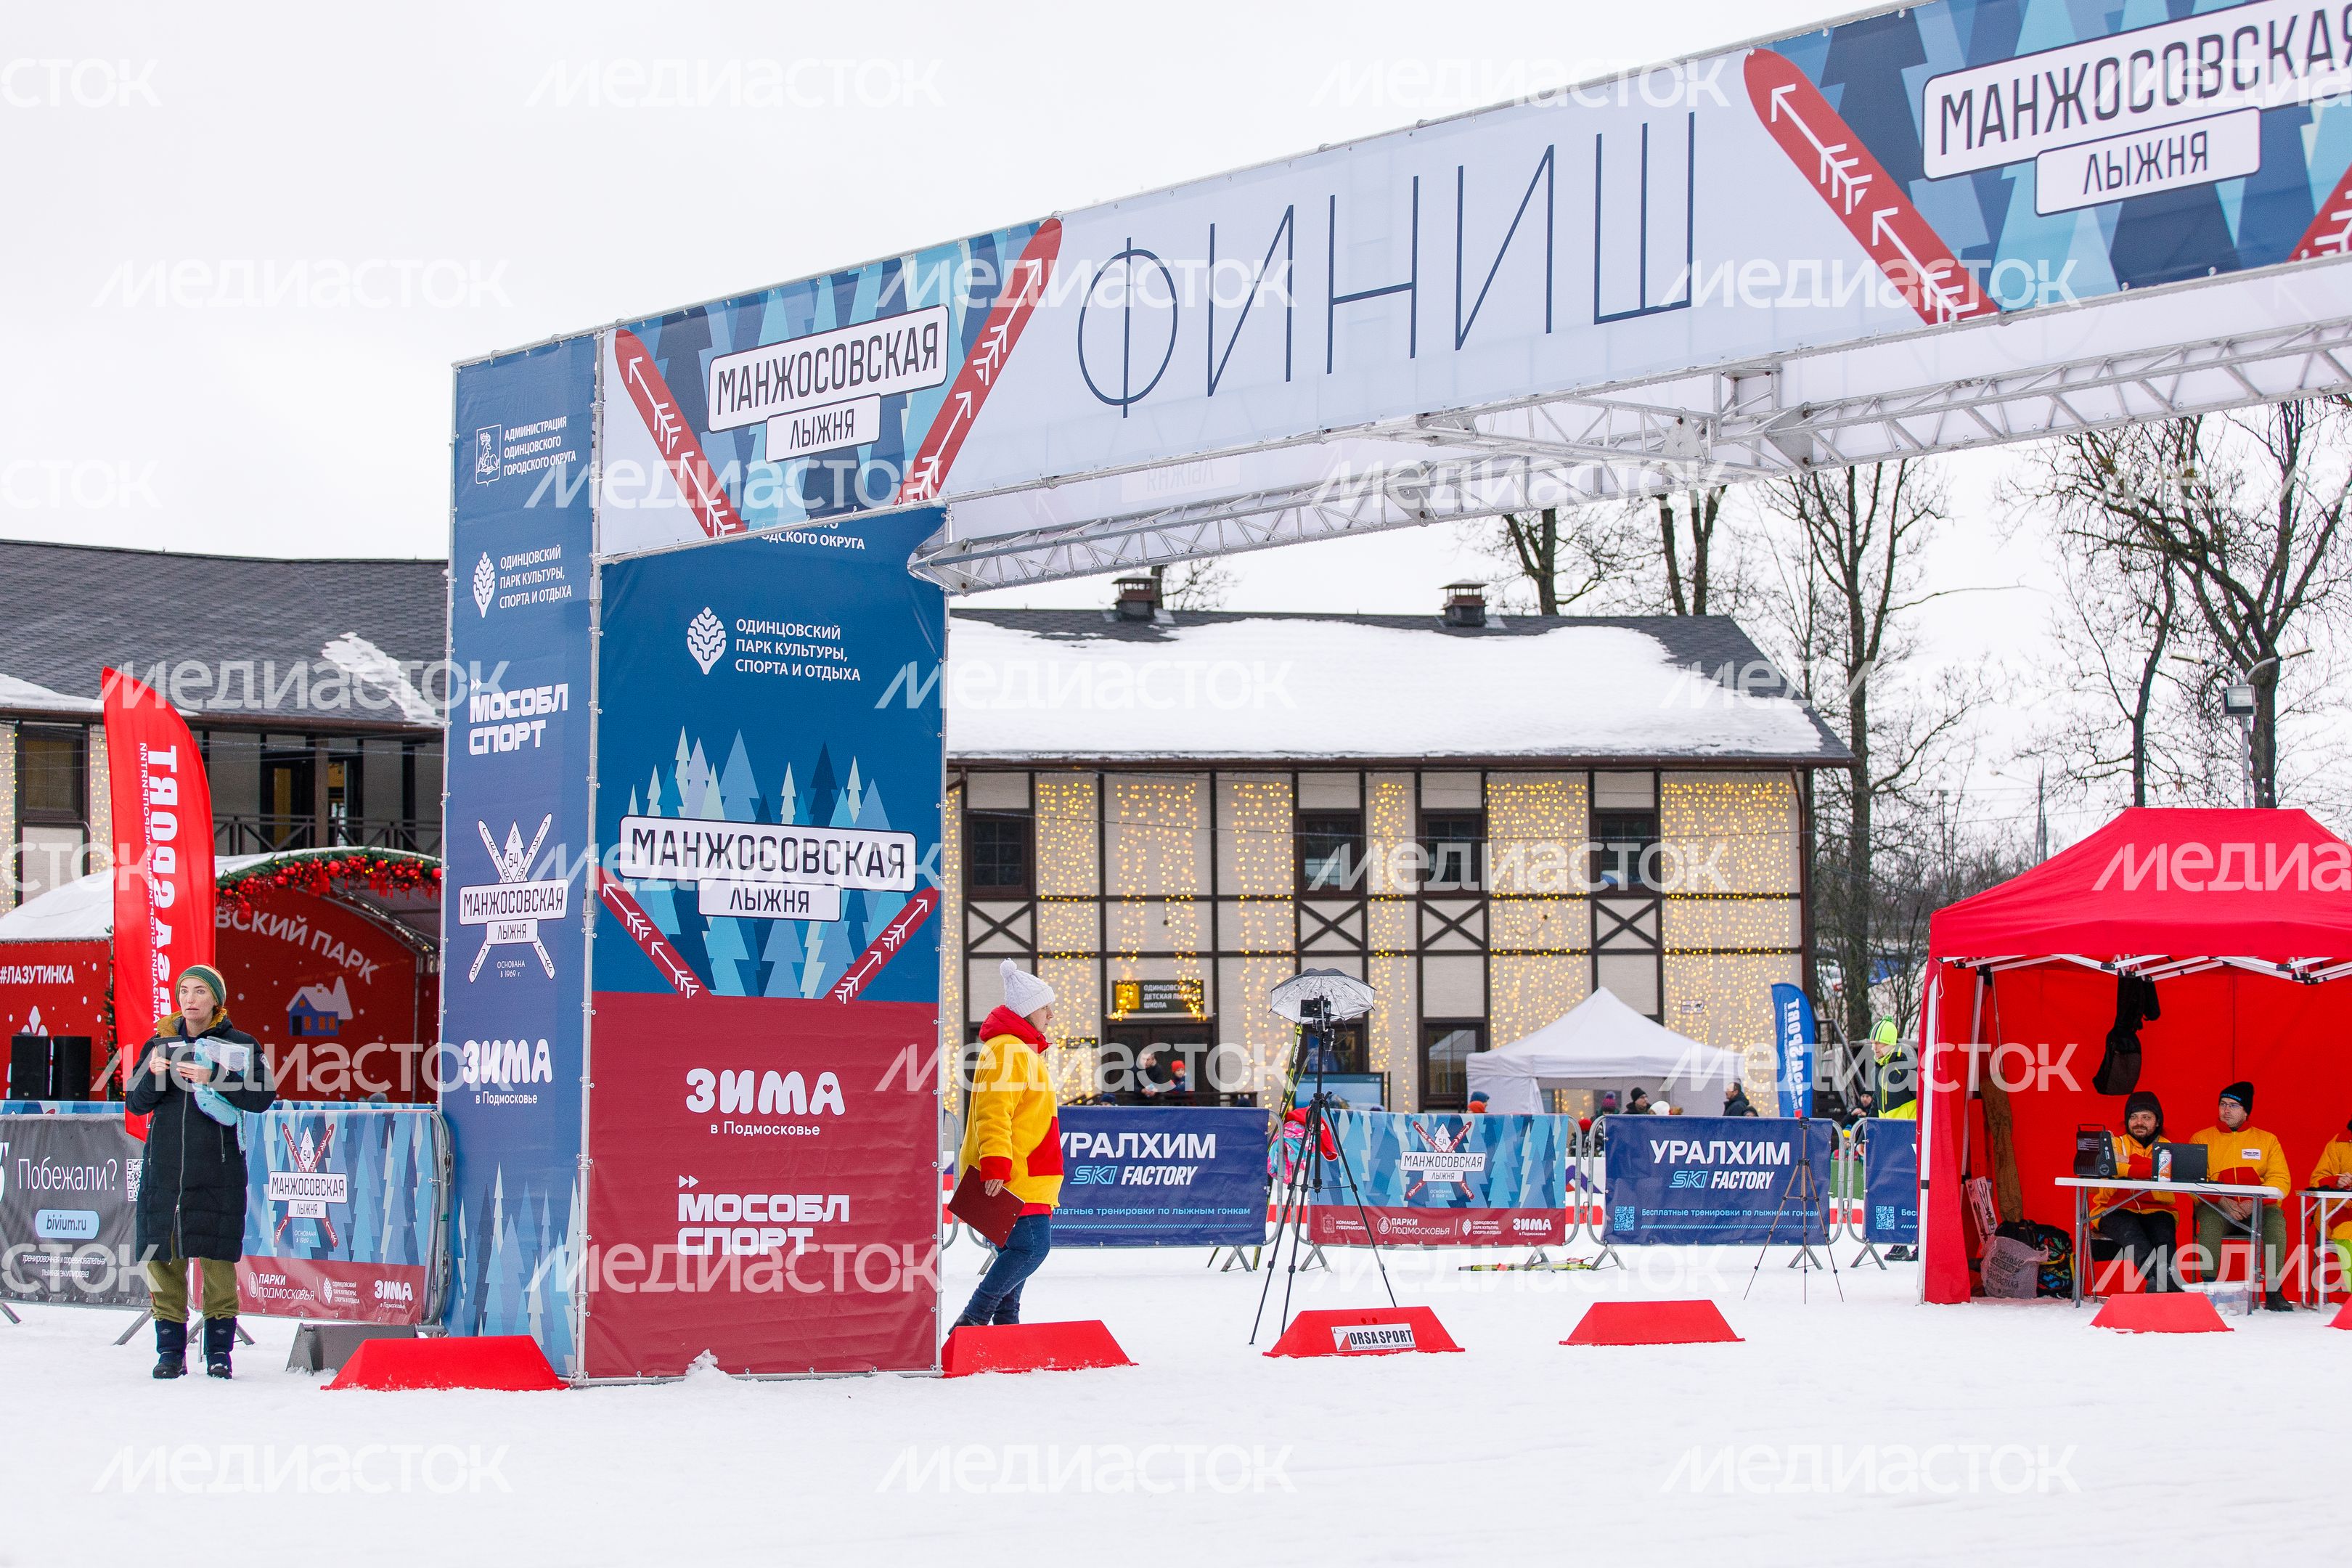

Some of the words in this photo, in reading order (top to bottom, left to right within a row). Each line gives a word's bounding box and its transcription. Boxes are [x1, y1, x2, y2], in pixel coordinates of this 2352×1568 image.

[2083, 130, 2209, 195] ЛЫЖНЯ
[1077, 111, 1694, 420] ФИНИШ
[717, 321, 939, 415] МАНЖОСОВСКАЯ
[504, 416, 567, 441] АДМИНИСТРАЦИЯ
[788, 408, 855, 450] ЛЫЖНЯ
[504, 436, 561, 460] ОДИНЦОВСКОГО
[504, 456, 548, 476] ГОРОДСКОГО
[550, 450, 576, 468] ОКРУГА
[820, 535, 865, 550] ОКРУГА
[500, 545, 561, 571] ОДИНЦОВСКИЙ
[500, 574, 520, 589] ПАРК
[522, 567, 565, 587] КУЛЬТУРЫ,
[499, 592, 529, 609] СПОРТА
[531, 590, 538, 603] И
[539, 584, 571, 605] ОТДЫХА
[736, 618, 841, 640] ОДИНЦОВСКИЙ
[735, 639, 772, 653] ПАРК
[775, 642, 848, 662] КУЛЬТУРЫ,
[735, 659, 788, 676] СПОРТА
[792, 665, 801, 676] И
[805, 664, 861, 681] ОТДЫХА
[470, 684, 568, 723] МОСОБЛ
[469, 720, 547, 756] СПОРТ
[509, 852, 519, 867] 54
[632, 828, 905, 880] МАНЖОСОВСКАЯ
[463, 888, 564, 917] МАНЖОСОВСКАЯ
[730, 886, 809, 913] ЛЫЖНЯ
[497, 923, 526, 940] ЛЫЖНЯ
[311, 930, 379, 984] ПАРК
[0, 965, 74, 984] #ЛАЗУТИНКА
[462, 1038, 552, 1084] ЗИМА
[483, 1090, 537, 1106] Подмосковье
[685, 1068, 845, 1116] ЗИМА
[711, 1124, 718, 1135] в
[724, 1121, 820, 1137] Подмосковье
[1439, 1138, 1447, 1146] 54
[1650, 1140, 1790, 1165] УРАЛХИМ
[303, 1150, 311, 1161] 54
[1404, 1156, 1482, 1168] МАНЖОСОВСКАЯ
[18, 1156, 118, 1191] Побежали?
[1070, 1165, 1118, 1185] SKI
[1121, 1165, 1199, 1185] FACTORY
[1669, 1170, 1708, 1188] SKI
[1710, 1171, 1775, 1190] FACTORY
[271, 1177, 344, 1197] МАНЖОСОВСКАЯ
[296, 1204, 318, 1215] ЛЫЖНЯ
[678, 1194, 849, 1222] МОСОБЛ
[1097, 1207, 1154, 1217] тренировки
[1691, 1209, 1740, 1218] тренировки
[46, 1214, 86, 1231] bivium.ru
[1513, 1218, 1552, 1231] ЗИМА
[678, 1228, 814, 1256] СПОРТ
[259, 1273, 286, 1286] ПАРКИ
[375, 1280, 413, 1301] ЗИМА
[258, 1287, 315, 1301] ПОДМОСКОВЬЯ
[1349, 1332, 1378, 1345] ORSA
[1379, 1330, 1413, 1344] SPORT
